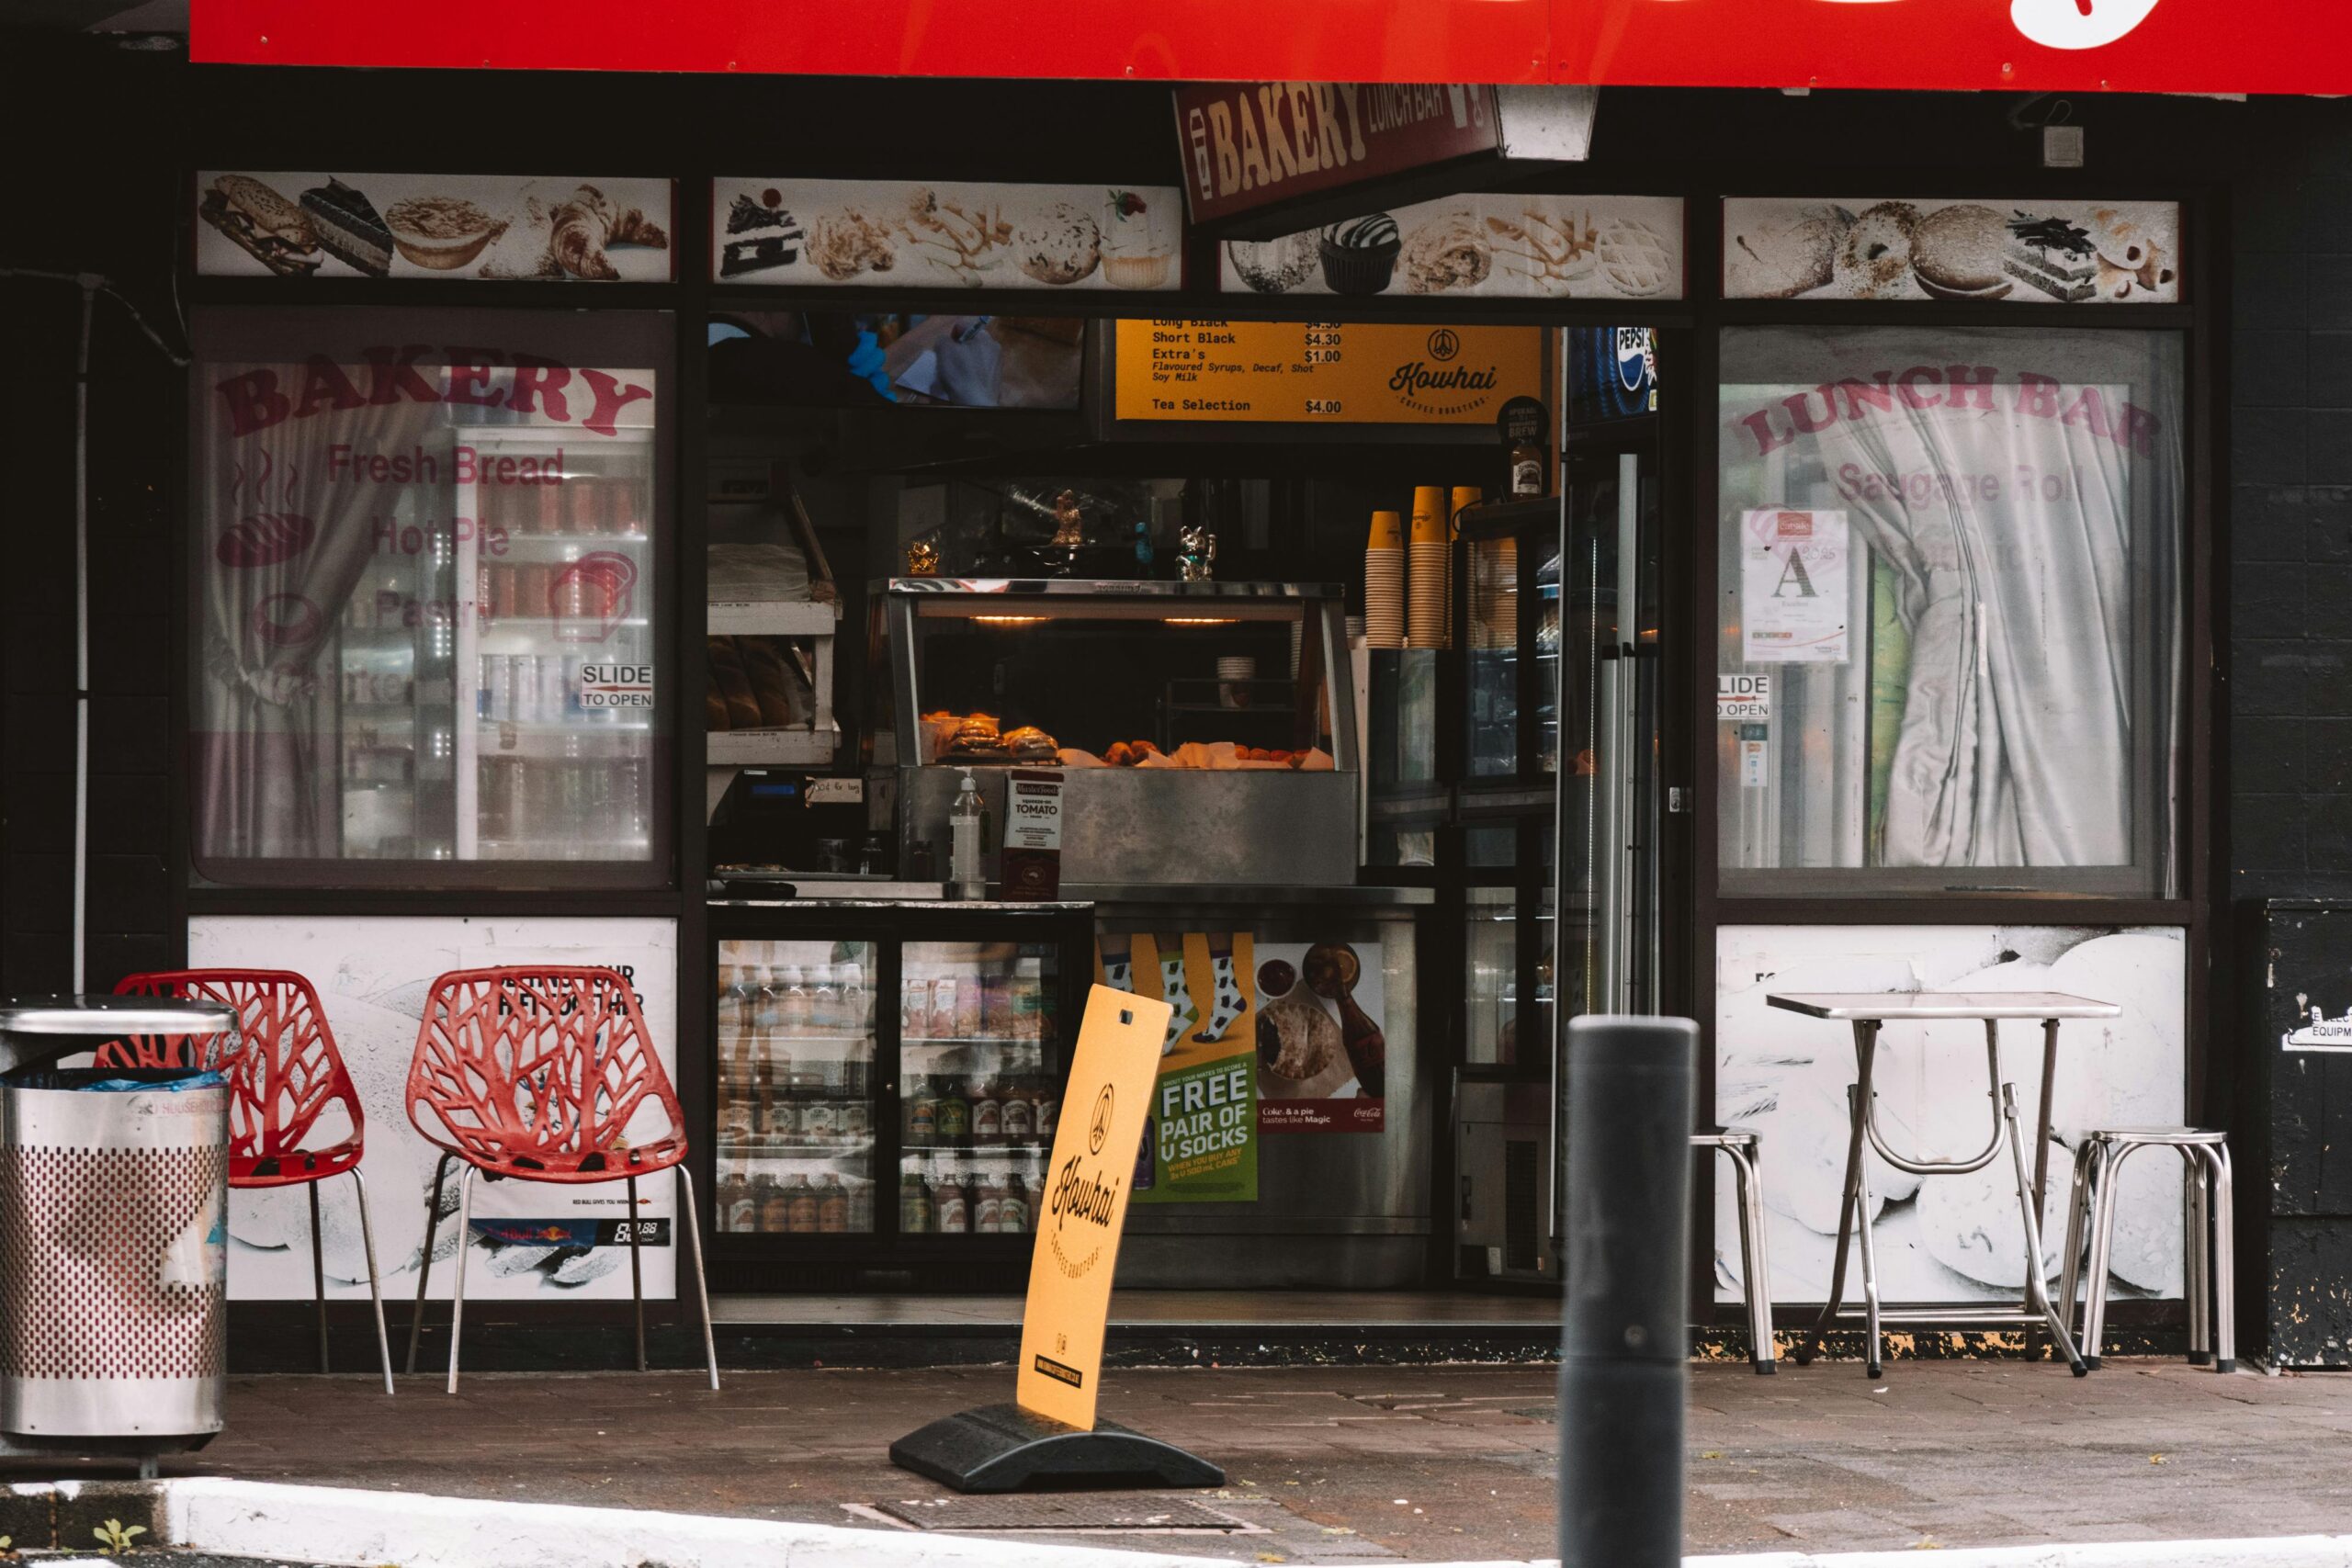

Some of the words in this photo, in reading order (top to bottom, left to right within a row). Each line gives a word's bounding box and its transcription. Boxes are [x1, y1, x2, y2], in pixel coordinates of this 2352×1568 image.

[1368, 85, 1414, 133] LUNCH
[1416, 84, 1445, 123] BAR
[1208, 82, 1366, 197] BAKERY
[1153, 320, 1182, 328] Long
[1153, 333, 1190, 344] Short
[1198, 333, 1236, 344] Black
[1305, 333, 1341, 346] $4.30
[1619, 327, 1645, 350] PEPSI
[1153, 349, 1205, 360] Extra's
[1305, 350, 1341, 364] $1.00
[1152, 362, 1203, 371] Flavoured
[1208, 363, 1246, 373] Syrups,
[1253, 364, 1284, 374] Decaf,
[1291, 364, 1315, 373] Shot
[1152, 373, 1170, 382] Soy
[1175, 372, 1198, 381] Milk
[1389, 362, 1497, 396] Kowhai
[216, 344, 652, 437] BAKERY
[1153, 399, 1174, 410] Tea
[1182, 399, 1250, 411] Selection
[1305, 400, 1341, 413] $4.00
[1399, 396, 1435, 414] COFFEE
[1742, 366, 1999, 456] LUNCH
[2014, 372, 2162, 457] BAR
[329, 445, 437, 484] Fresh
[453, 446, 564, 485] Bread
[2014, 465, 2084, 503] Roll
[371, 517, 439, 556] Hot
[453, 518, 510, 555] Pie
[1770, 546, 1820, 598] A
[377, 591, 497, 637] Pastry
[583, 666, 651, 683] SLIDE
[583, 694, 605, 706] TO
[609, 694, 652, 706] OPEN
[1726, 704, 1769, 716] OPEN
[1015, 805, 1057, 815] TOMATO
[2312, 1026, 2352, 1037] EQUIPM
[1163, 1077, 1181, 1087] SHOUT
[1182, 1075, 1196, 1083] YOUR
[1162, 1069, 1248, 1118] FREE
[1300, 1108, 1314, 1116] pie
[1305, 1116, 1330, 1124] Magic
[1161, 1111, 1213, 1143] PAIR
[1219, 1103, 1247, 1127] OF
[1180, 1126, 1248, 1159] SOCKS
[1168, 1159, 1192, 1172] WHEN
[1193, 1156, 1207, 1165] YOU
[1208, 1152, 1224, 1162] BUY
[1226, 1147, 1242, 1157] ANY
[1052, 1155, 1119, 1231] Kowhai
